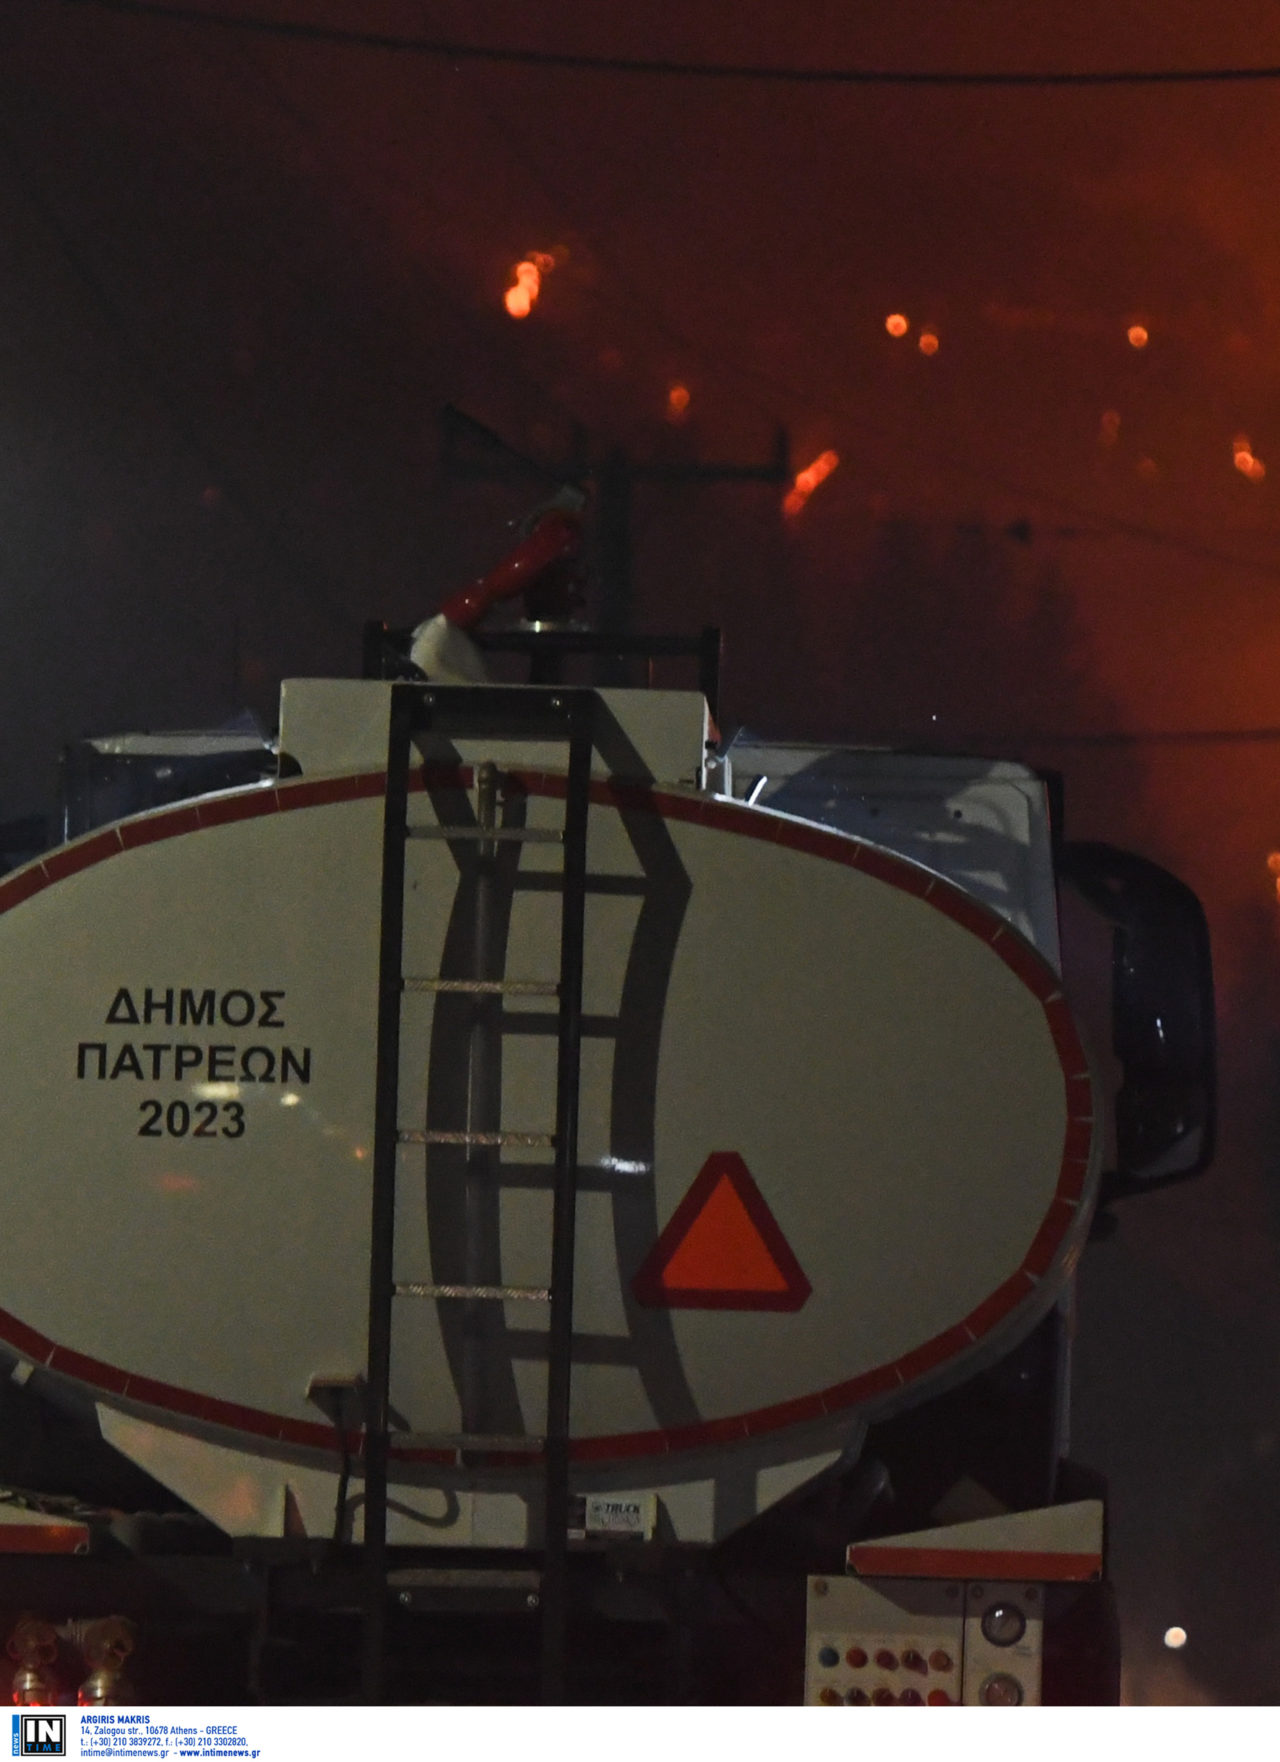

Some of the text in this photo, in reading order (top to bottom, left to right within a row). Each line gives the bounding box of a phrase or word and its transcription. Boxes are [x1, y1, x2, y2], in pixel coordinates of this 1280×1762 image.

[105, 989, 286, 1028] ΔΗΜΟΣ
[77, 1042, 312, 1083] ΠΑΤΡΕΩΝ
[138, 1099, 246, 1138] 2023
